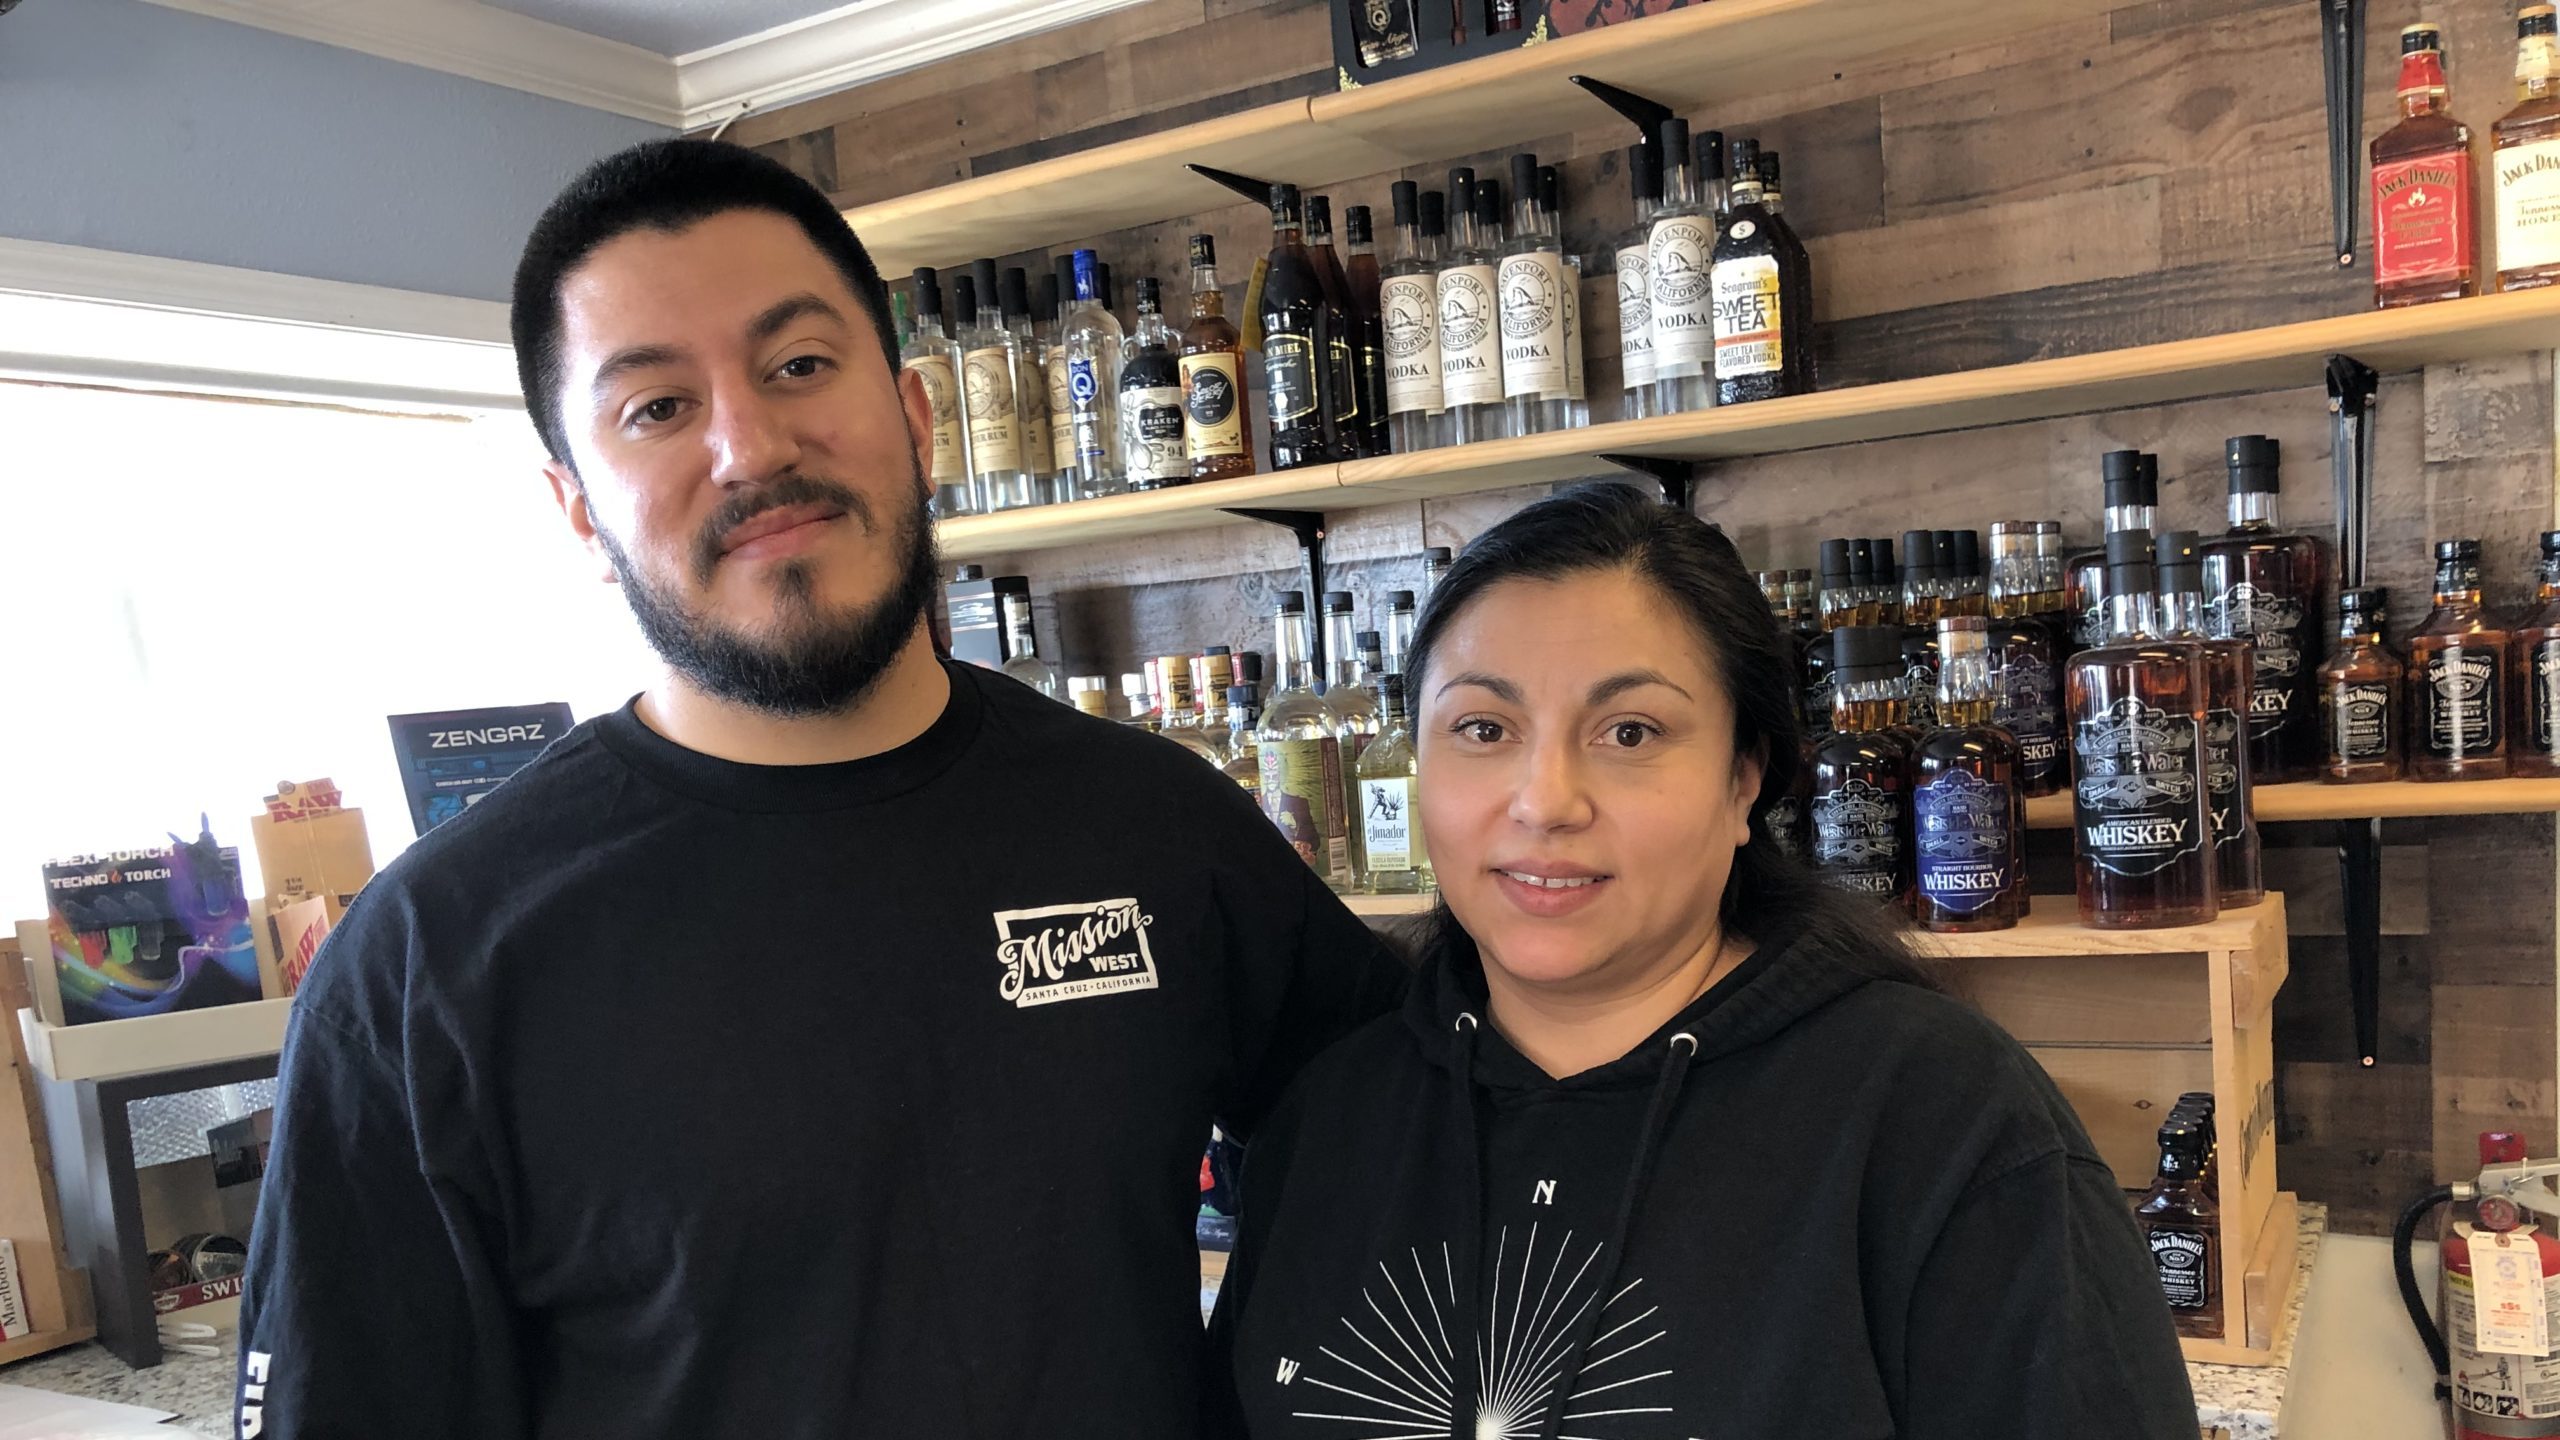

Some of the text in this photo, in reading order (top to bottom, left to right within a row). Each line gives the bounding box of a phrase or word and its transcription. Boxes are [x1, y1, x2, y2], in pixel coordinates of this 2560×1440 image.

[2502, 160, 2534, 188] JACK
[1650, 226, 1710, 260] DAVENPORT
[1654, 272, 1710, 299] CALIFORNIA
[1721, 276, 1768, 296] Seagram's
[1712, 292, 1779, 319] SWEET
[1502, 305, 1552, 331] CALIFORNIA
[1658, 312, 1708, 330] VODKA
[1724, 310, 1767, 335] TEA
[1384, 325, 1431, 350] ALIFORNIA
[1505, 343, 1550, 362] VODKA
[1741, 344, 1753, 356] TEA
[1753, 352, 1777, 364] VODKA
[1072, 372, 1094, 397] Q
[1140, 417, 1179, 427] KRAKEN
[934, 437, 950, 447] UM
[988, 430, 1008, 441] RUM
[2451, 660, 2492, 680] DANIEL'S
[2356, 688, 2388, 706] DANIEL'S
[429, 724, 546, 749] ZENGAZ
[2022, 741, 2057, 760] SKEY
[2088, 780, 2181, 798] SMALL BATCH
[1370, 824, 1406, 843] Jimador
[2087, 818, 2188, 847] WHISKEY
[50, 868, 172, 889] TECHNO TORCH
[1923, 868, 2005, 891] WHISKEY
[997, 905, 1154, 1001] Mission
[1088, 953, 1139, 973] WEST
[1025, 975, 1151, 1001] SANTA CRUZ CALIFORNIA
[1532, 1179, 1557, 1205] N
[2151, 1235, 2205, 1256] JACK DANIEL'S
[2159, 1265, 2197, 1276] Tennessee
[201, 1275, 245, 1302] SWI
[2160, 1278, 2196, 1286] WHISKEY
[1275, 1356, 1300, 1386] W
